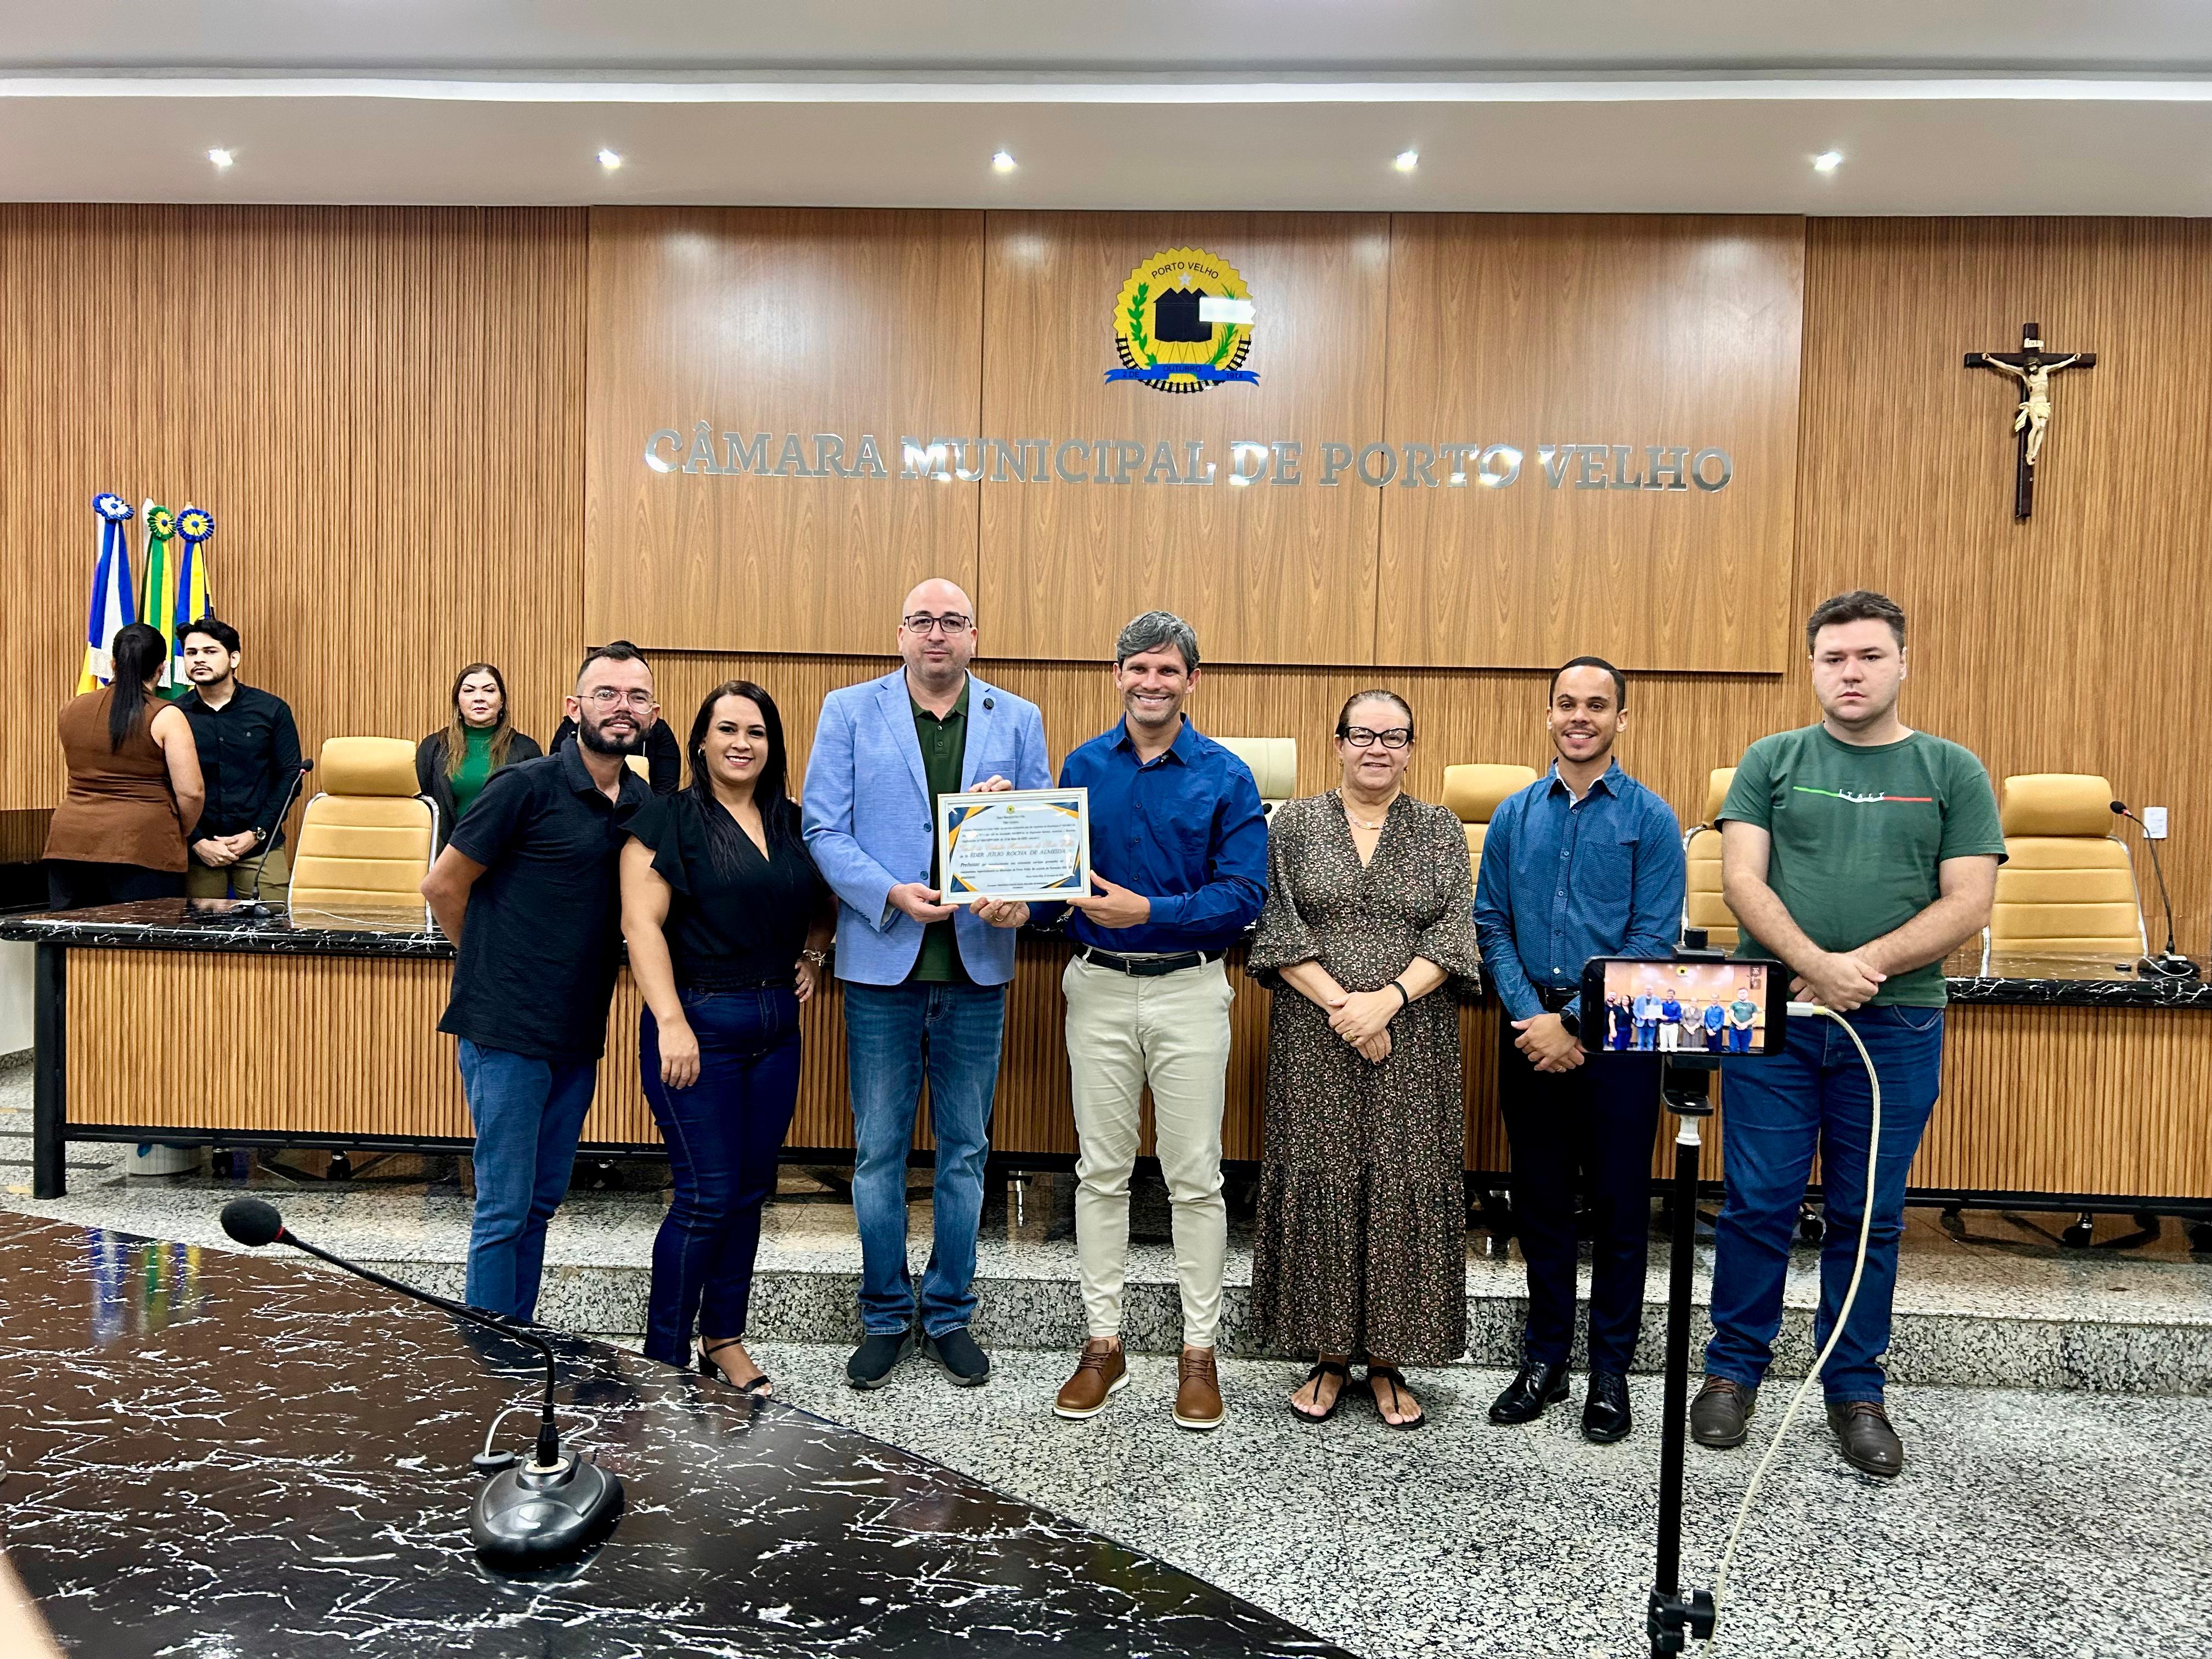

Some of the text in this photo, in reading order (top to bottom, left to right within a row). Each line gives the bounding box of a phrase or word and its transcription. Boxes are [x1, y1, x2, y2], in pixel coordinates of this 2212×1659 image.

[1152, 262, 1219, 279] PORTO VELHO
[644, 420, 1734, 493] CÂMARA MUNICIPAL DE PORTO VELHO
